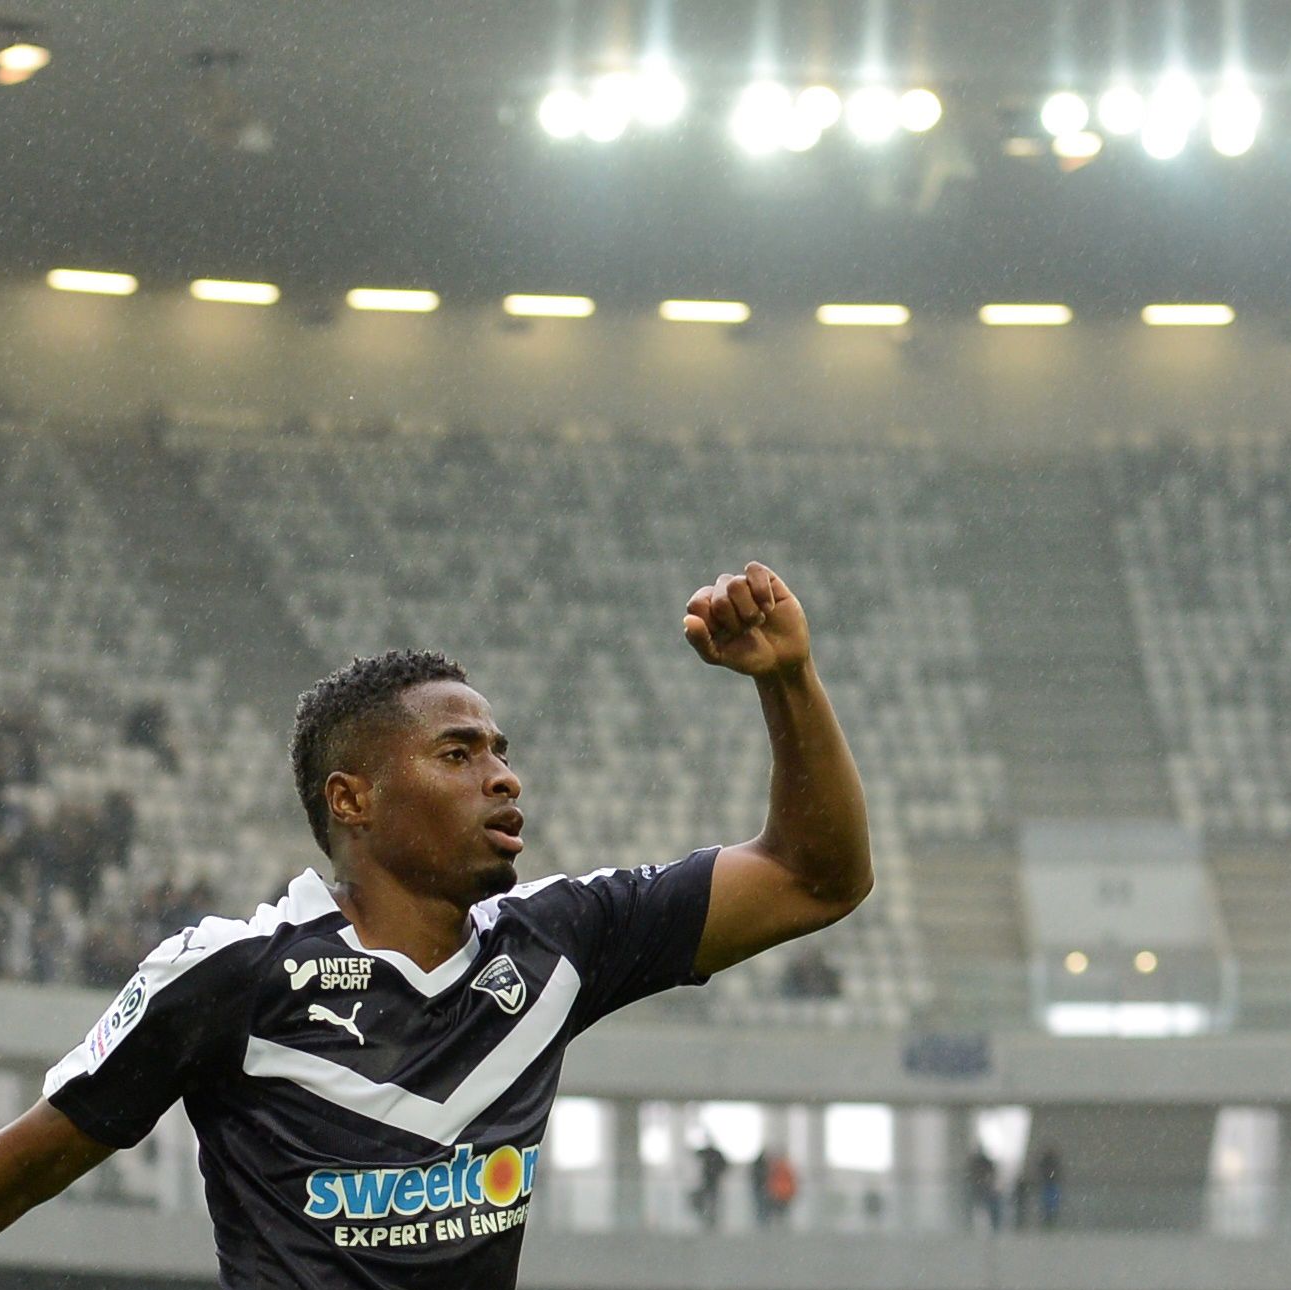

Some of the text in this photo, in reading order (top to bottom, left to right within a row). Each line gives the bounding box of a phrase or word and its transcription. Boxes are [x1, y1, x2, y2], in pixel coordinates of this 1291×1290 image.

[318, 957, 372, 974] INTER
[320, 973, 372, 990] SPORT
[334, 1222, 429, 1247] EXPERT
[435, 1217, 465, 1241] EN
